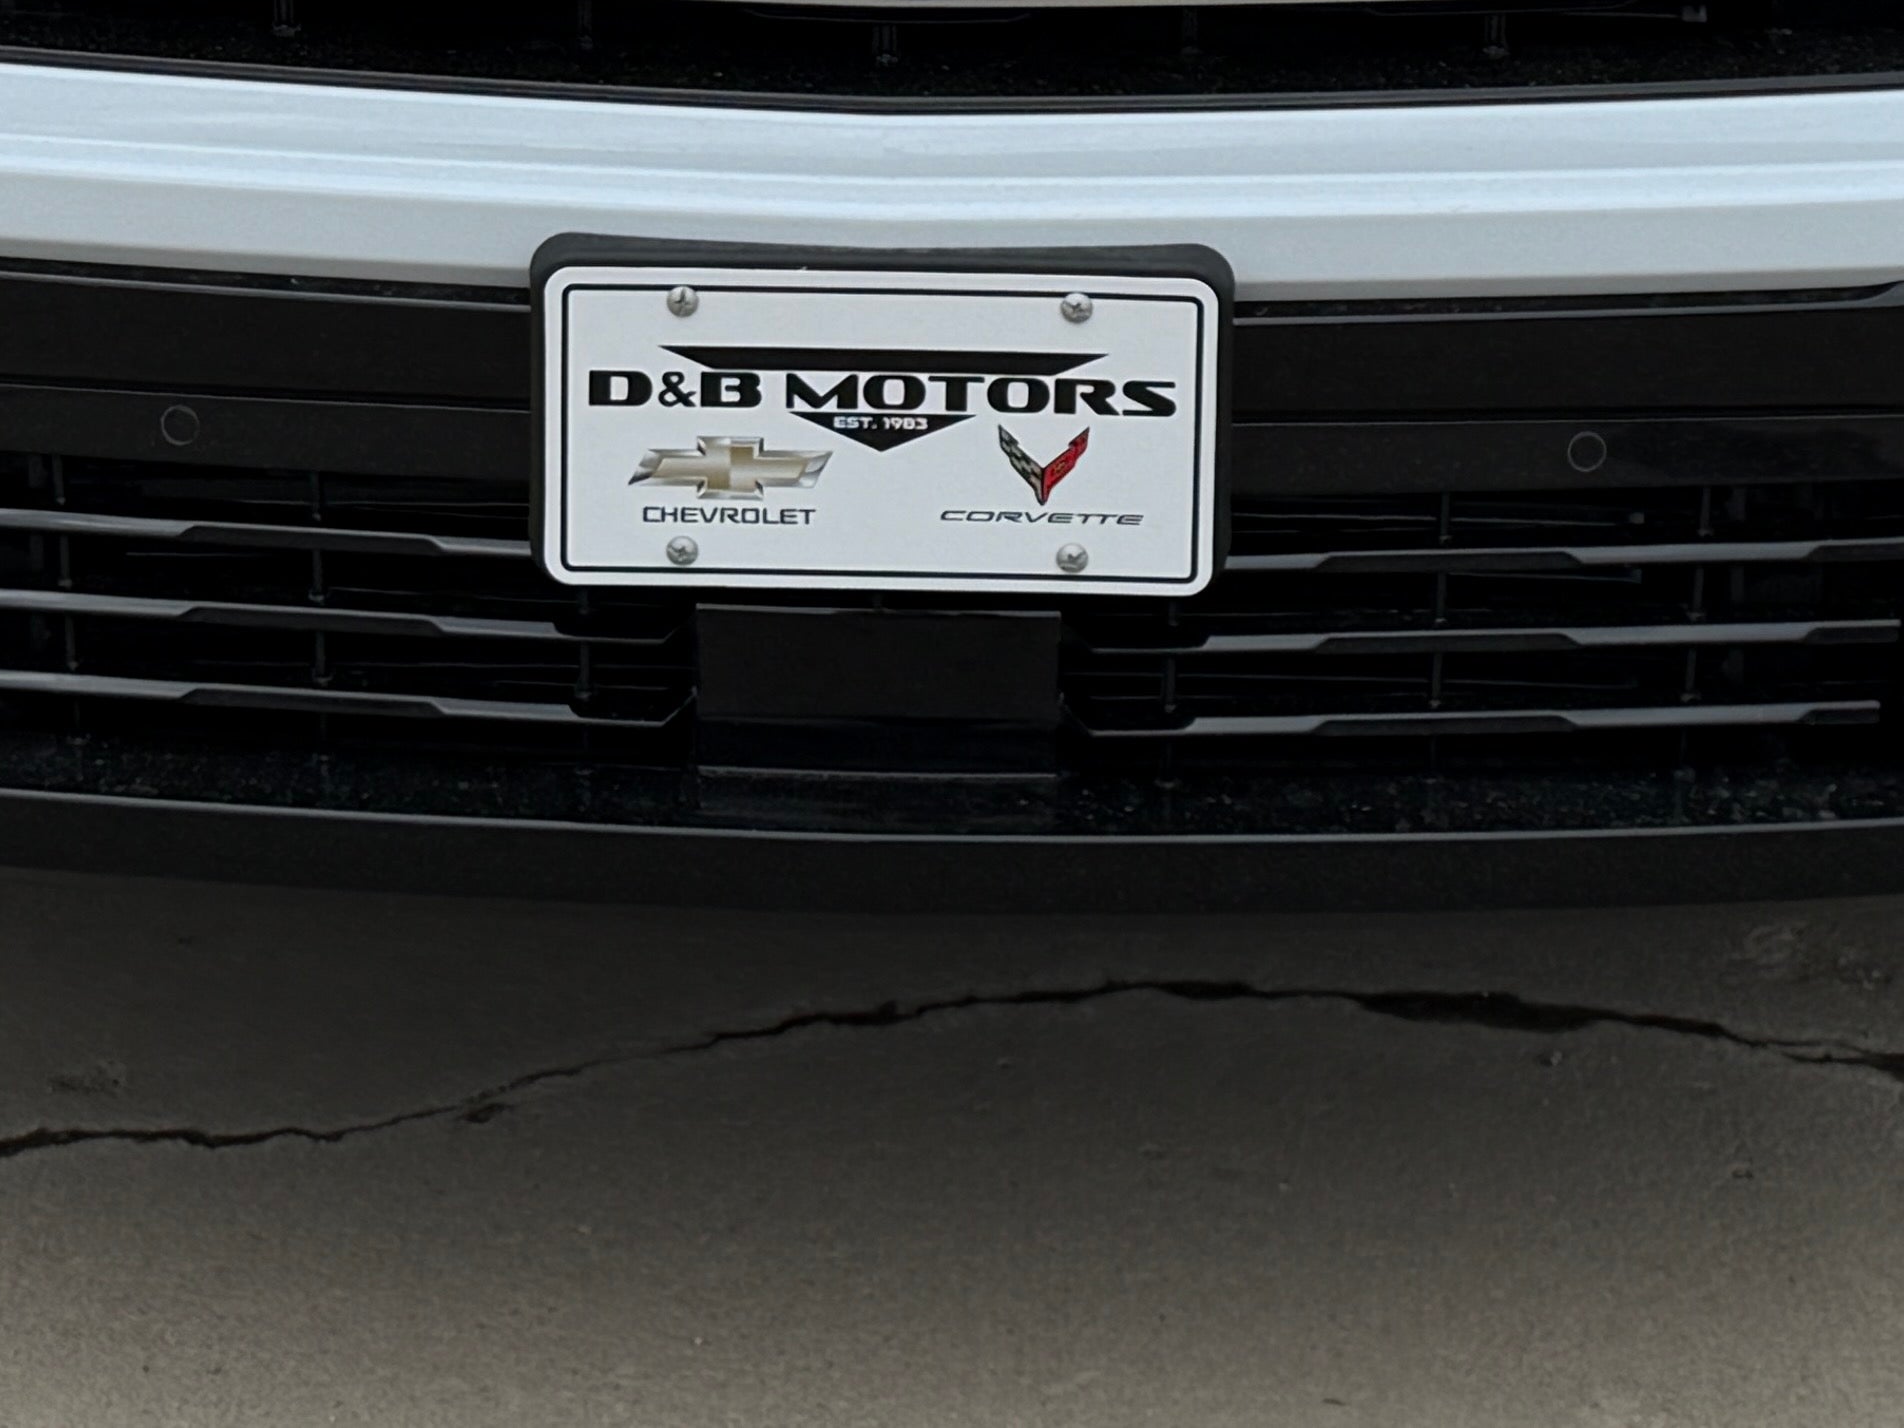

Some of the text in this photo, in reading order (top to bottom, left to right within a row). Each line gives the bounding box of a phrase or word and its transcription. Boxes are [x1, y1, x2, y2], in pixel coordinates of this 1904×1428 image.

[588, 370, 1178, 417] D&B MOTORS
[833, 416, 878, 430] EST.
[642, 506, 817, 525] CHEVROLET
[940, 509, 1145, 526] CORVETTE
